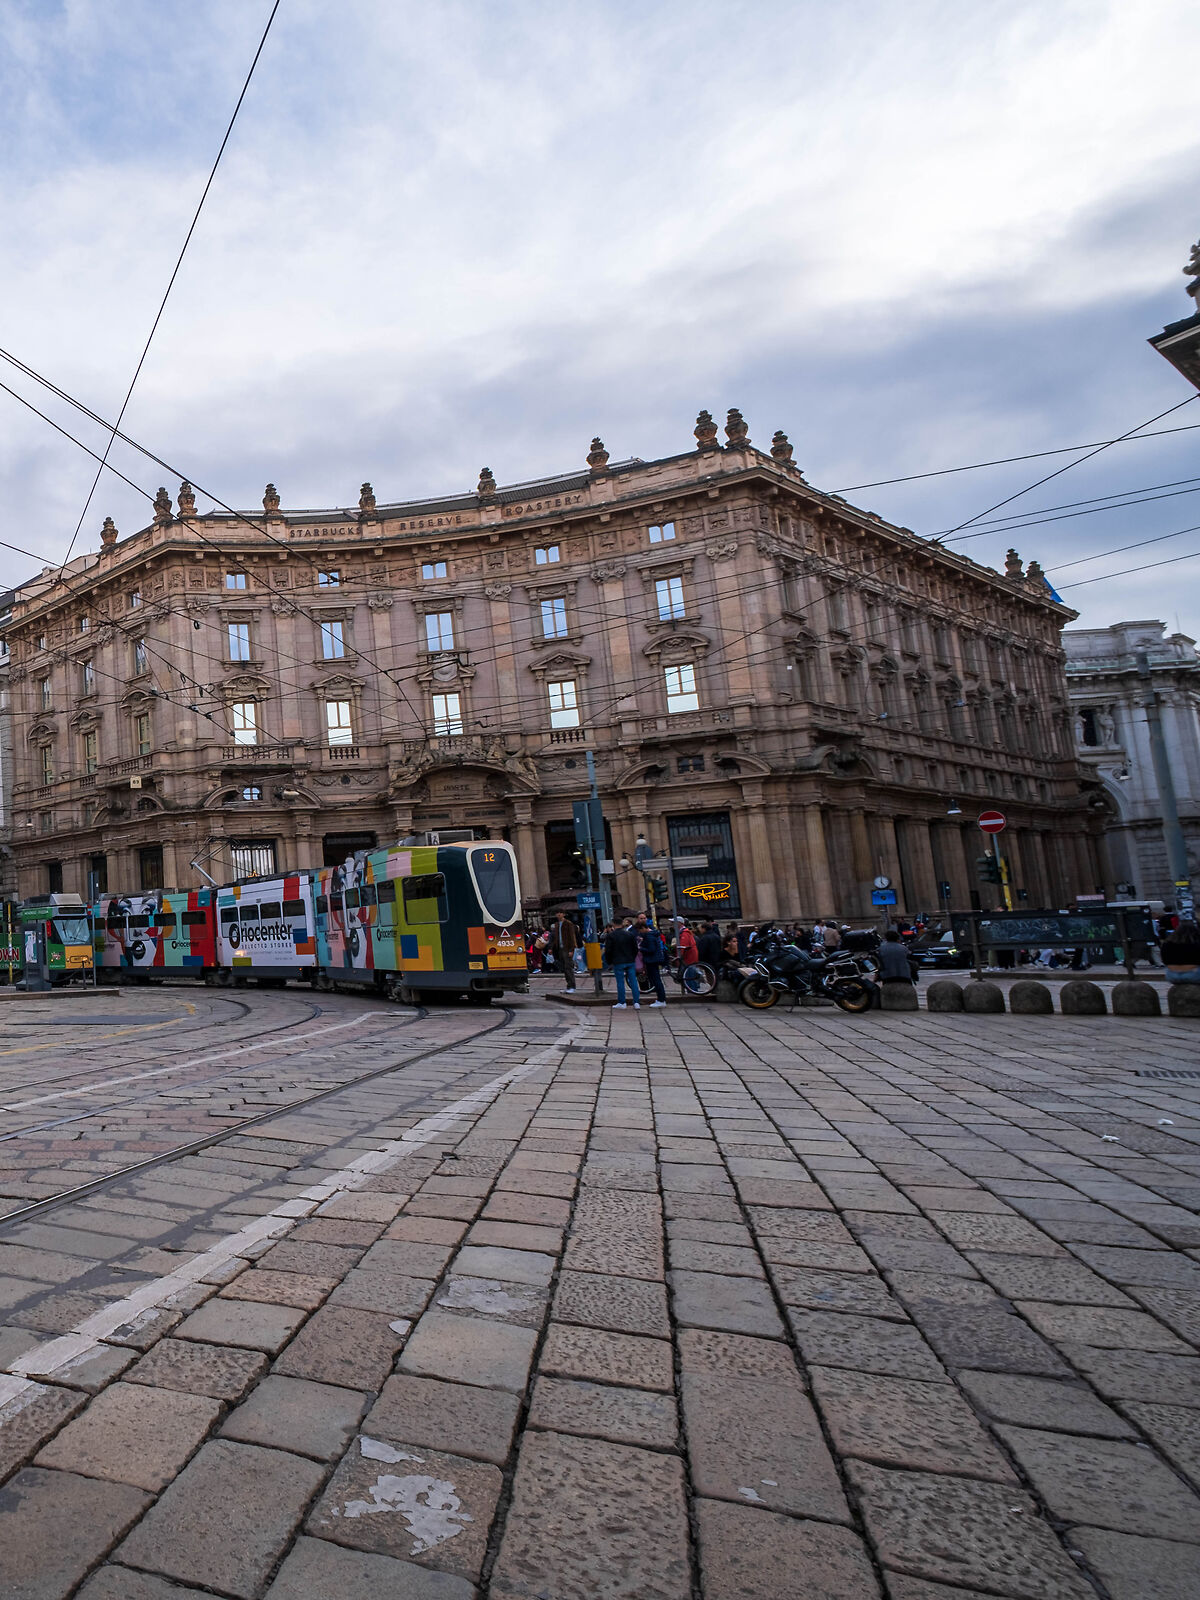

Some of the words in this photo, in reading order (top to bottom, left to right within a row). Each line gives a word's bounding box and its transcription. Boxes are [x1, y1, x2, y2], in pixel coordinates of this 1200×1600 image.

[290, 526, 361, 538] STARBUCKS
[400, 515, 462, 530] RESERVE
[506, 495, 581, 516] ROASTERY
[484, 853, 495, 862] 12
[229, 921, 293, 949] Oriocenter
